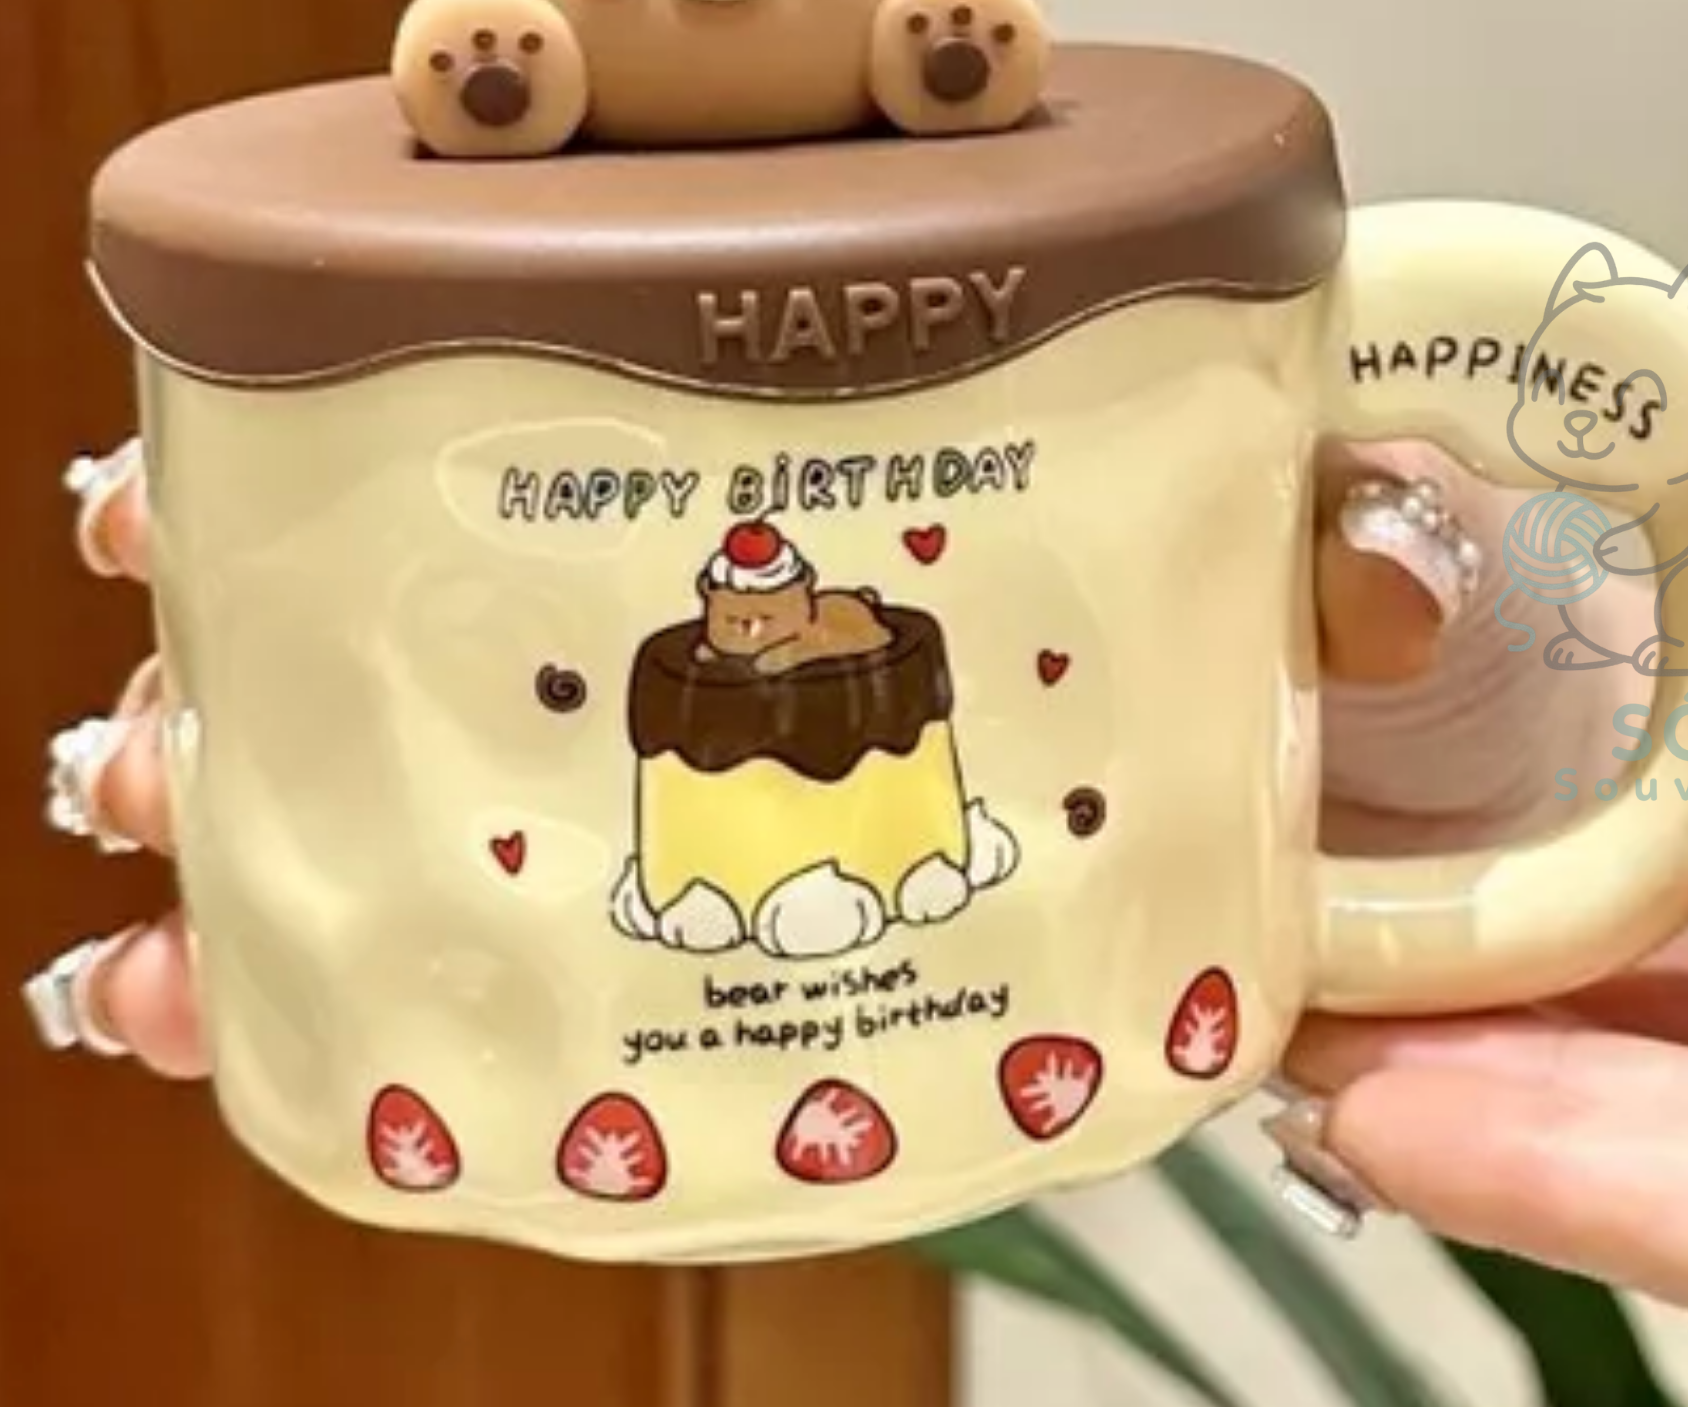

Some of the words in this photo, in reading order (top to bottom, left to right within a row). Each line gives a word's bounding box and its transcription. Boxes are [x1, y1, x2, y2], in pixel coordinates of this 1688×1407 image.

[698, 267, 1026, 366] HAPPY
[1350, 336, 1664, 441] HAPPINESS
[499, 466, 700, 520] HAPPY
[624, 1025, 687, 1063] you
[699, 1025, 724, 1049] a
[735, 1014, 845, 1050] happy
[857, 984, 1010, 1038] birthday
[704, 975, 787, 1009] bear
